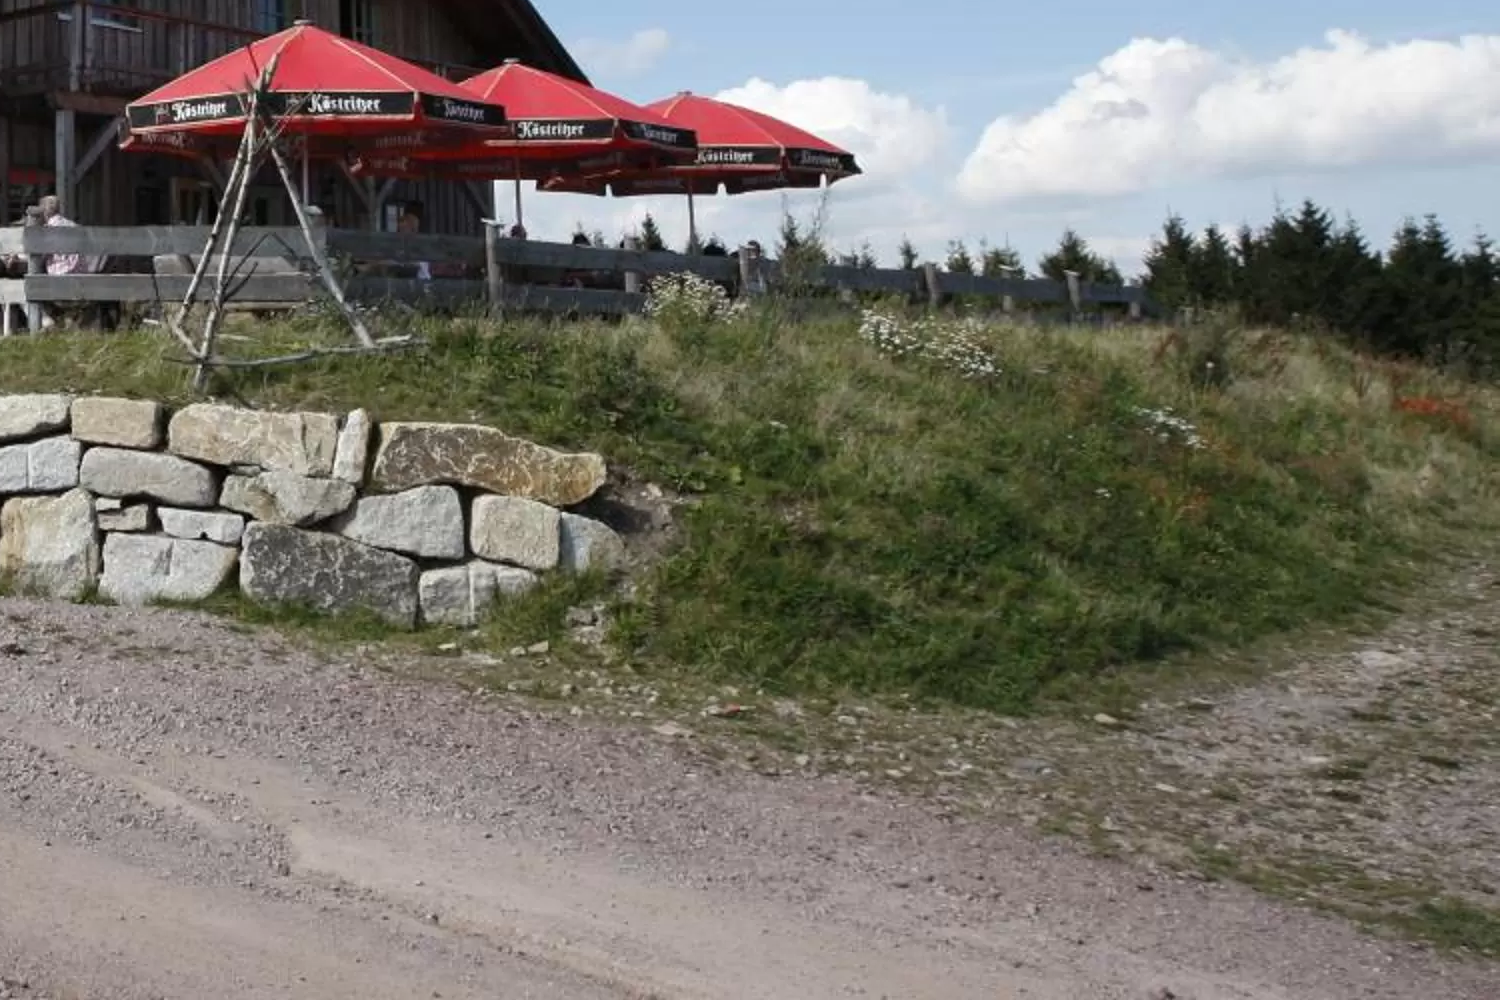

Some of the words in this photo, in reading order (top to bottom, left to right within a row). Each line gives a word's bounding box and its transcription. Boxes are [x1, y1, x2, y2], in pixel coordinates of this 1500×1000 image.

[172, 98, 228, 121] Köstritzer
[308, 92, 381, 114] Köstritzer
[517, 121, 585, 139] Köstritzer
